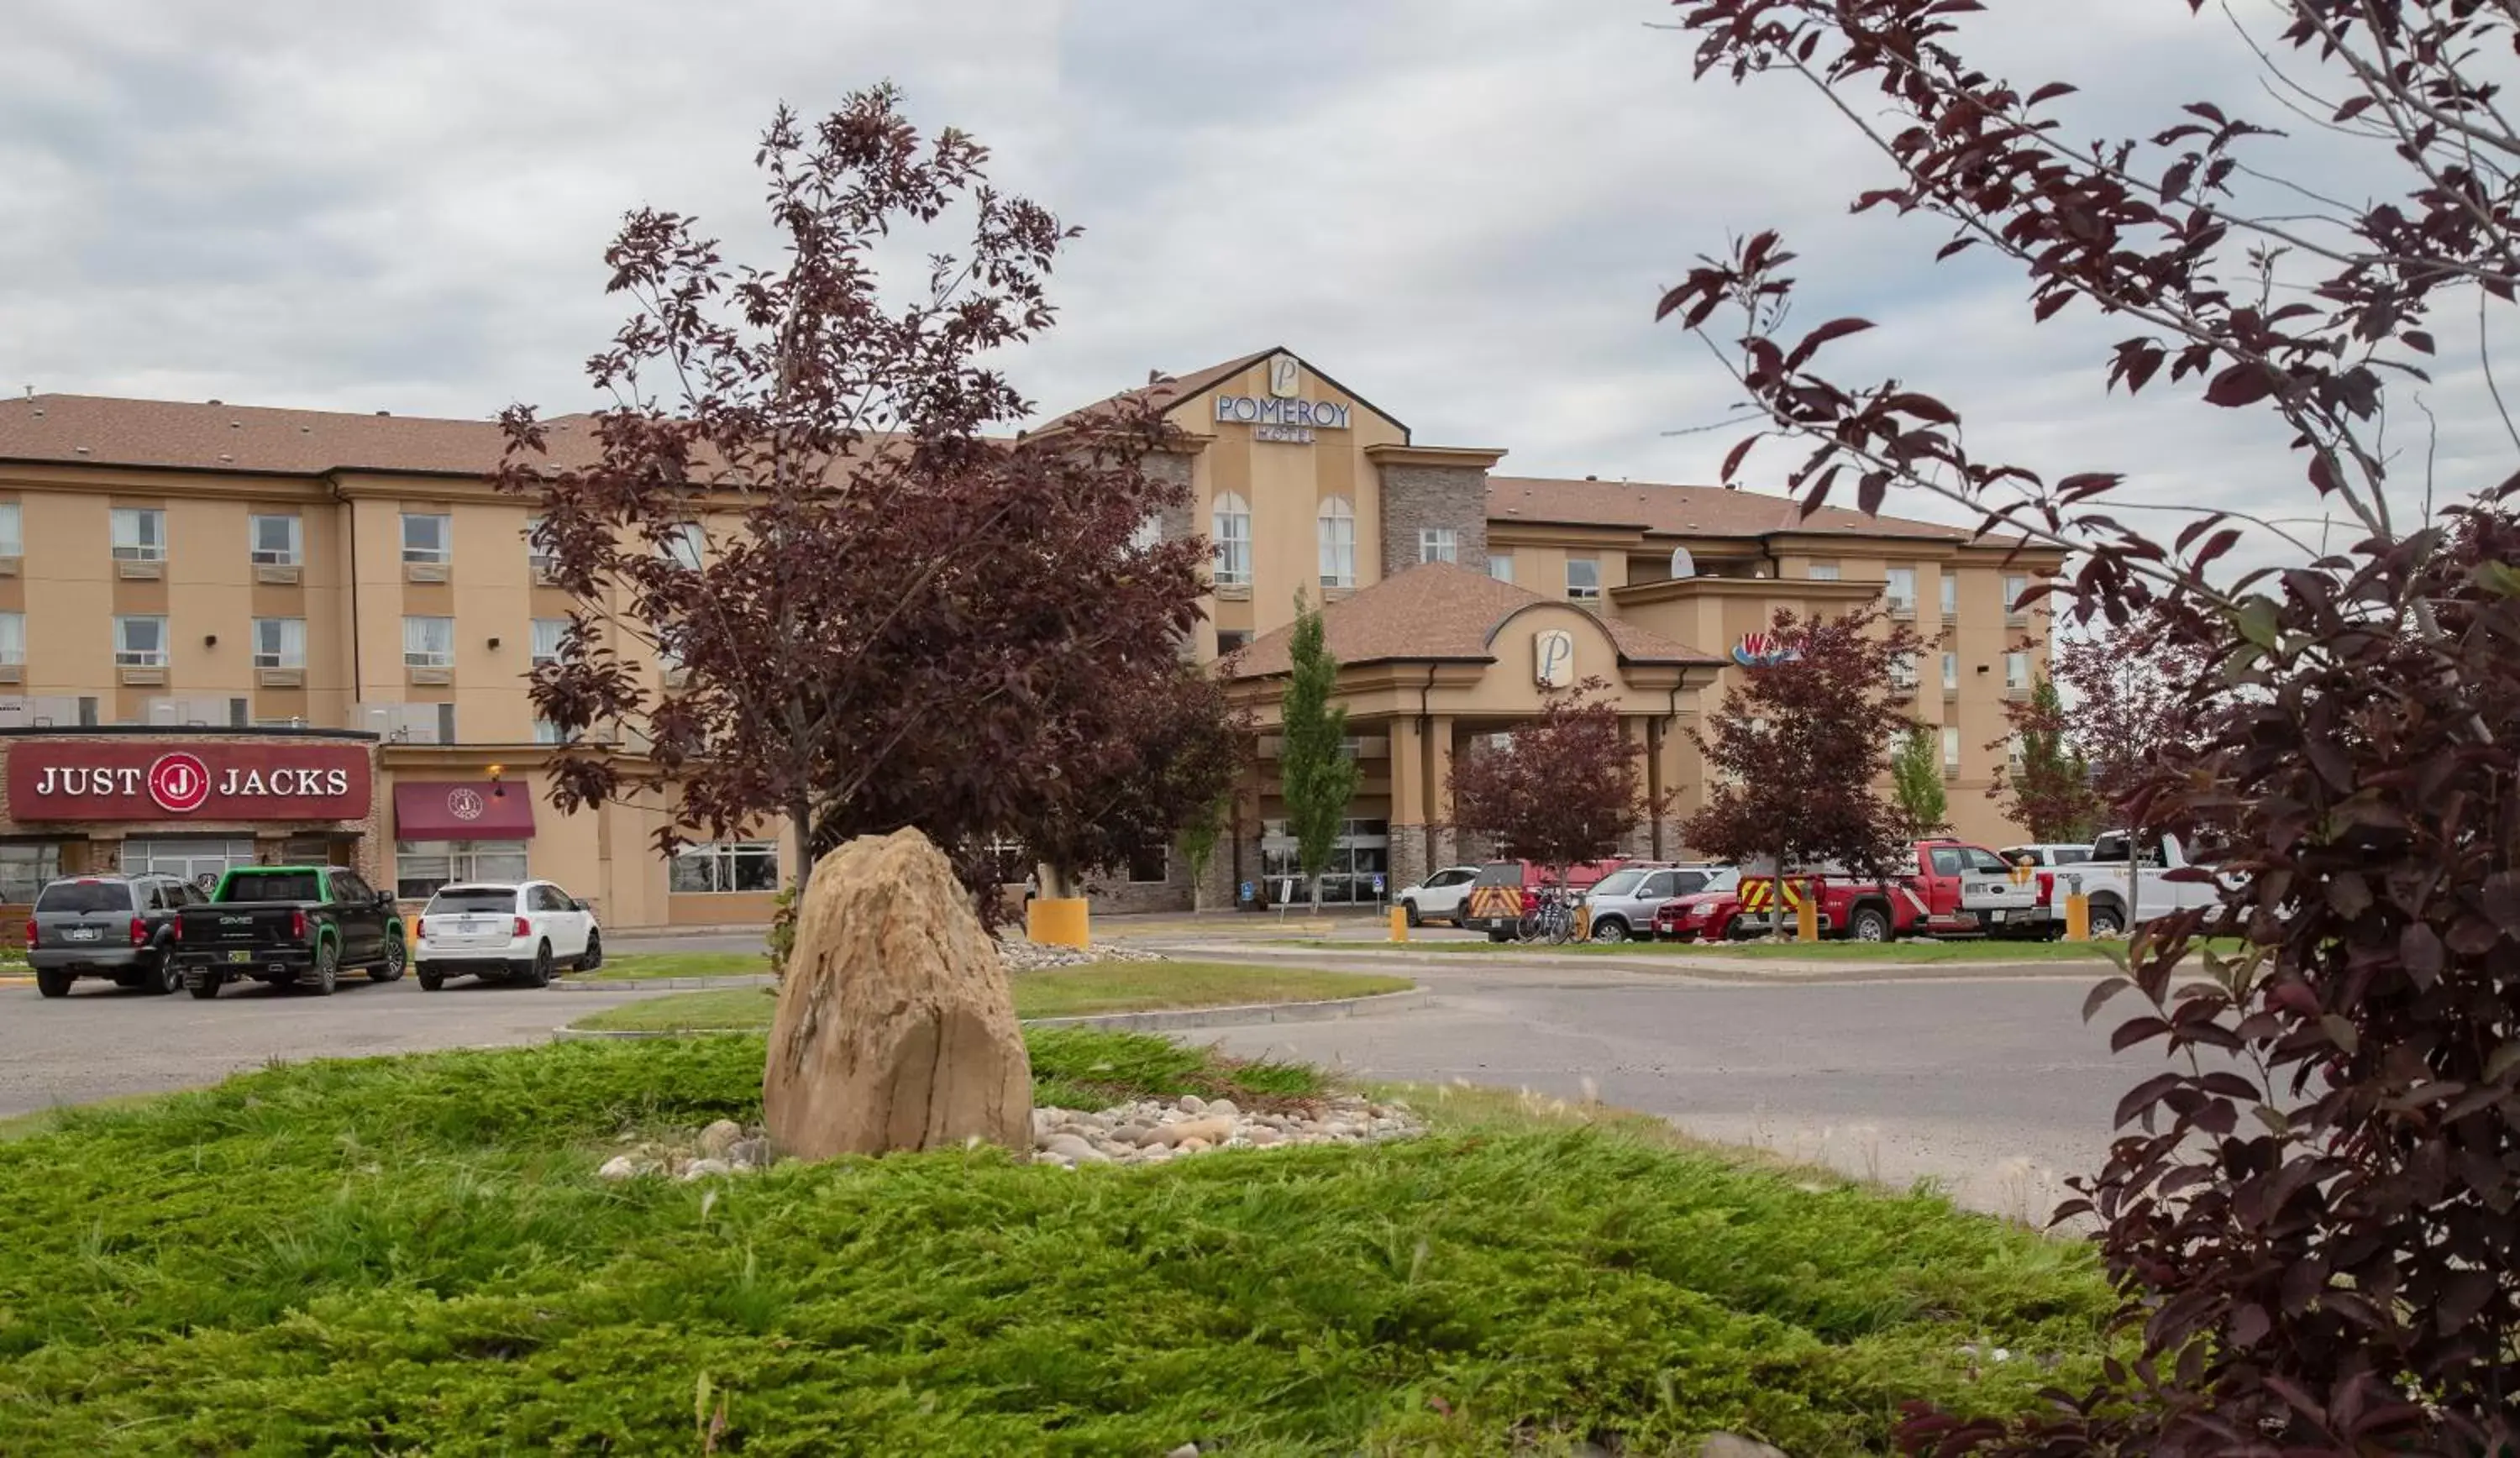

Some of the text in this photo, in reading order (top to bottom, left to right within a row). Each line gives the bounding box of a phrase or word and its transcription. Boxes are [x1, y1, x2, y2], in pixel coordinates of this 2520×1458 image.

[1219, 396, 1350, 430] POMEROY
[36, 767, 349, 796] JUST J JACKS
